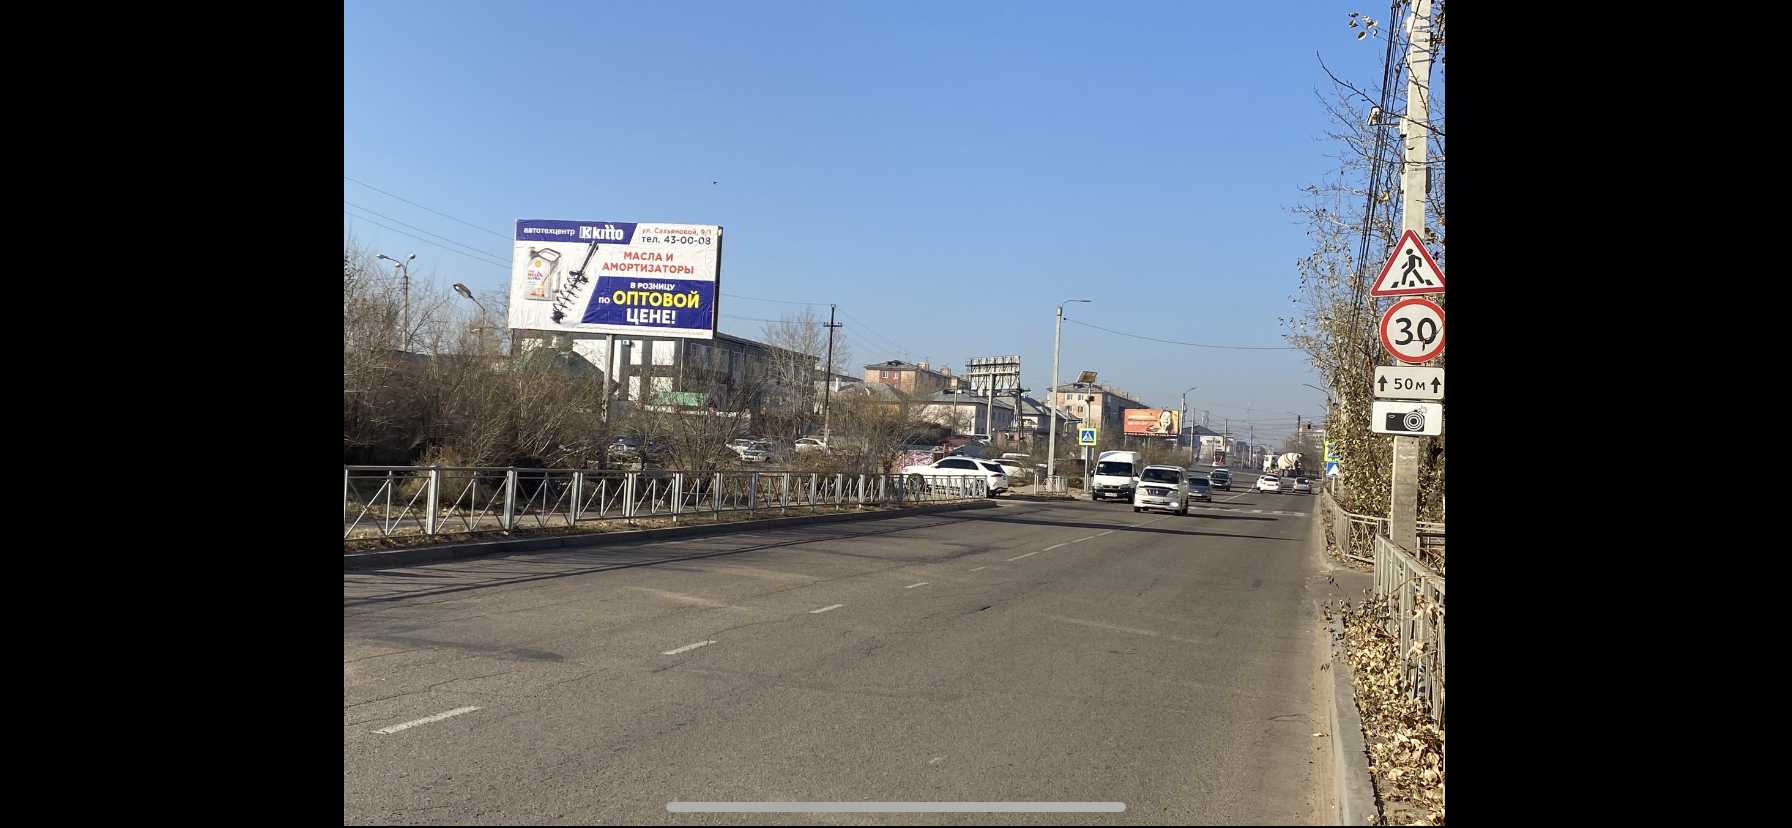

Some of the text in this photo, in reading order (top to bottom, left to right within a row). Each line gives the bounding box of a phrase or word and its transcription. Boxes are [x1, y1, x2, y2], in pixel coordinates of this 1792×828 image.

[664, 236, 711, 245] 43-00-08
[624, 252, 673, 262] МАСЛА И
[602, 262, 694, 274] АМОРТИЗАТОРЫ
[637, 282, 675, 291] РОЗНИЦУ
[612, 290, 700, 308] ОПТОВОЙ
[626, 308, 676, 325] ЦЕНЕ!
[1395, 318, 1437, 346] 30
